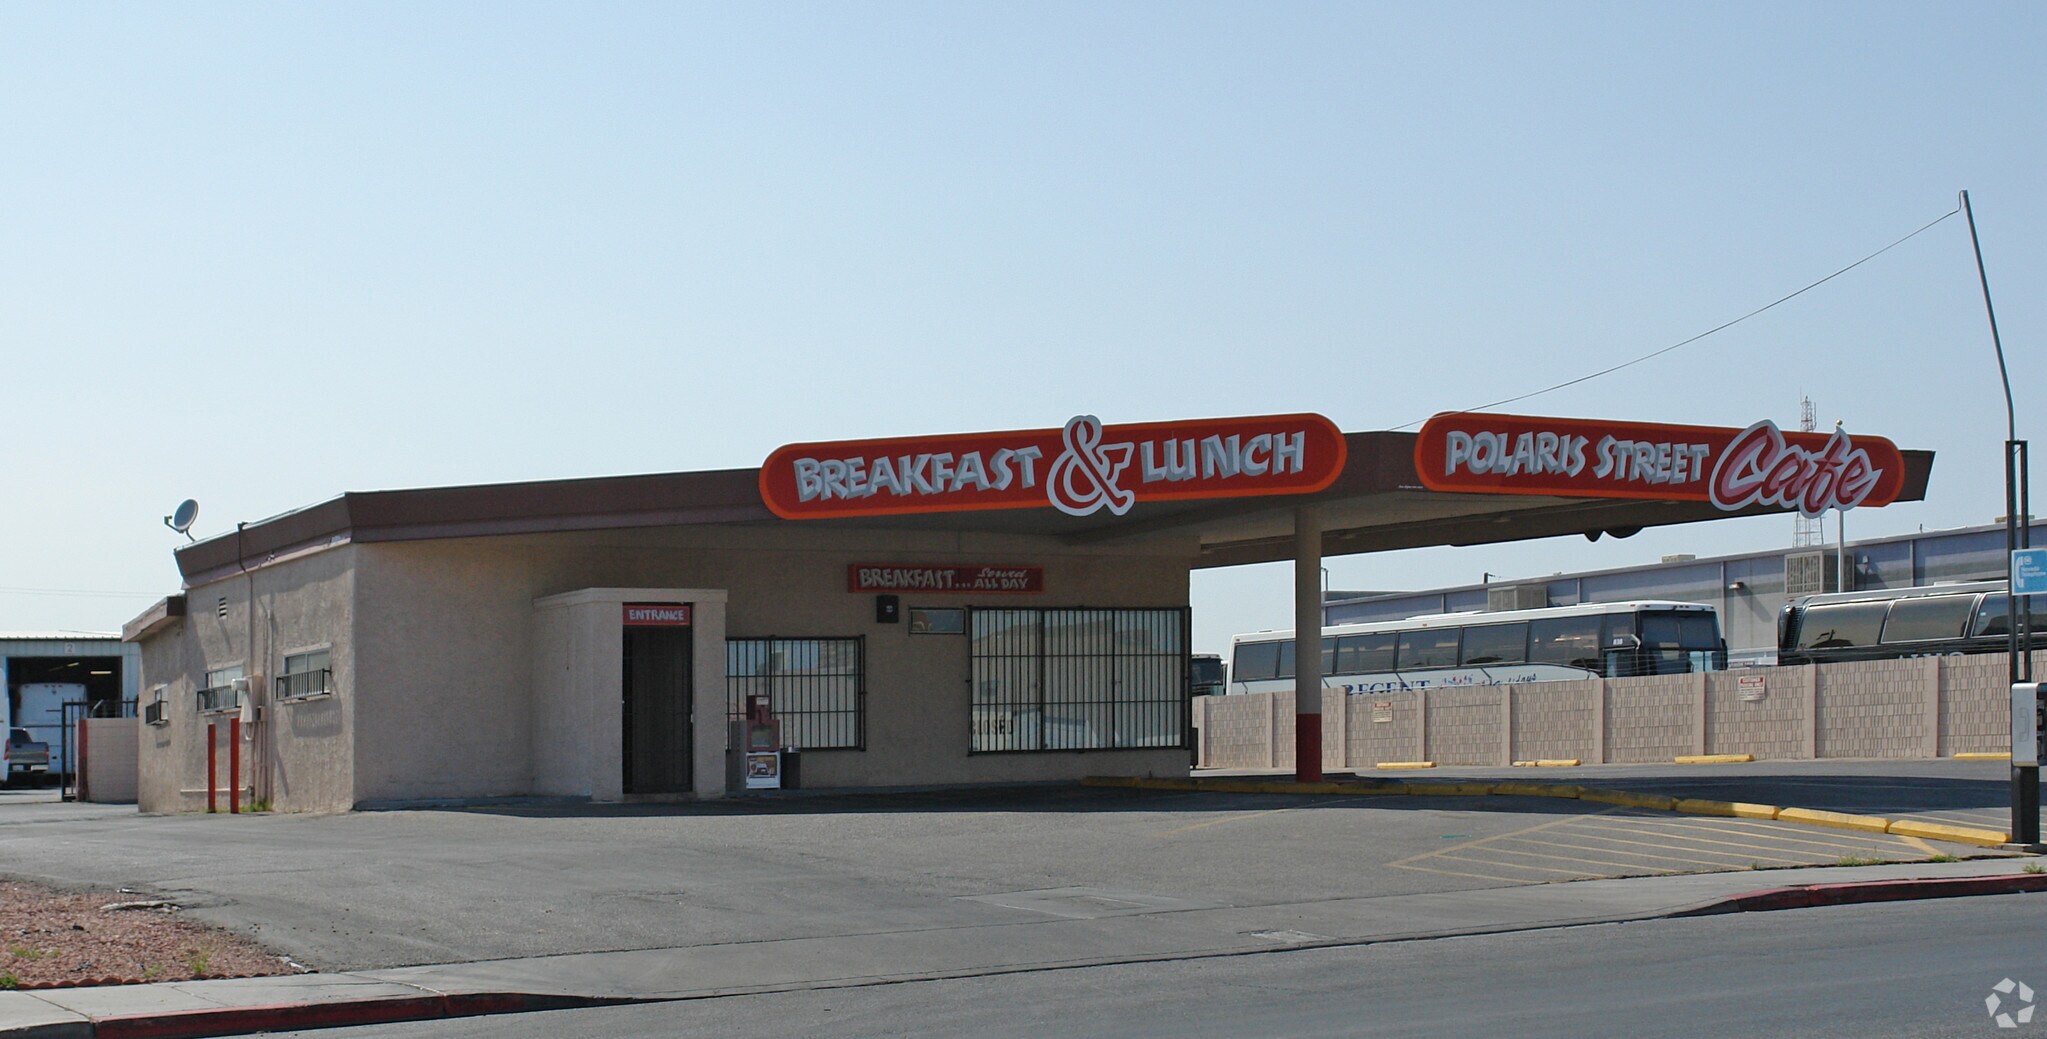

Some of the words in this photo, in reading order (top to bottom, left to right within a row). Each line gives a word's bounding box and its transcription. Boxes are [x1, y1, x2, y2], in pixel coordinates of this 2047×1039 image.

[1445, 431, 1587, 478] POLARIS
[1593, 434, 1710, 484] STREET
[792, 445, 1044, 502] BREAKFAST
[1046, 414, 1134, 516] &
[1141, 431, 1306, 481] LUNCH
[978, 567, 1028, 577] Served
[974, 578, 998, 588] ALL
[1001, 578, 1029, 590] DAY
[628, 609, 685, 621] ENTRANCE
[66, 643, 73, 652] 2
